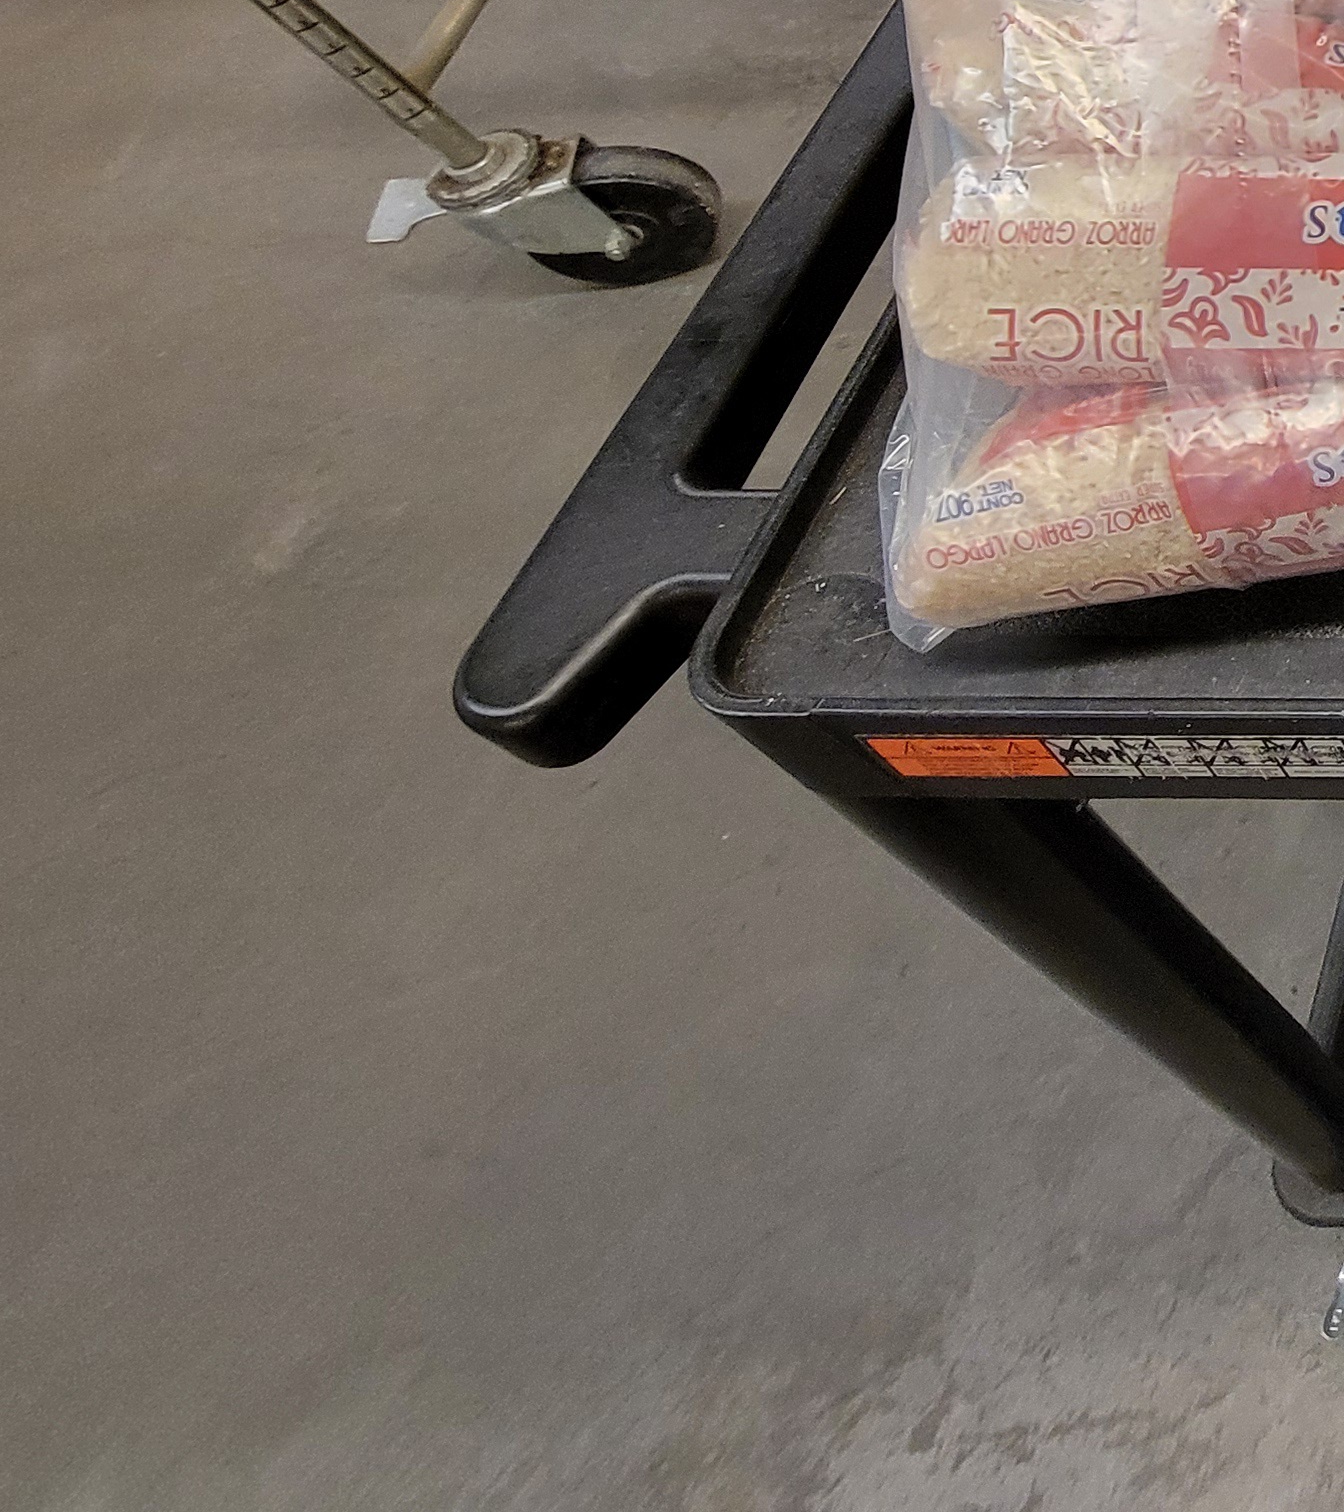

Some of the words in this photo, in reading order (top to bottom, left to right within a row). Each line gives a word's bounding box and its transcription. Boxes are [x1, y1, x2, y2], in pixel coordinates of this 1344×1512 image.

[997, 218, 1076, 247] GRANO
[1086, 219, 1156, 246] ARROZ
[986, 307, 1150, 363] RICE
[935, 493, 975, 524] 907
[977, 491, 1025, 512] CONT
[1105, 500, 1173, 534] ARROZ
[1013, 517, 1094, 551] GRANO
[925, 535, 1007, 570] LARGO
